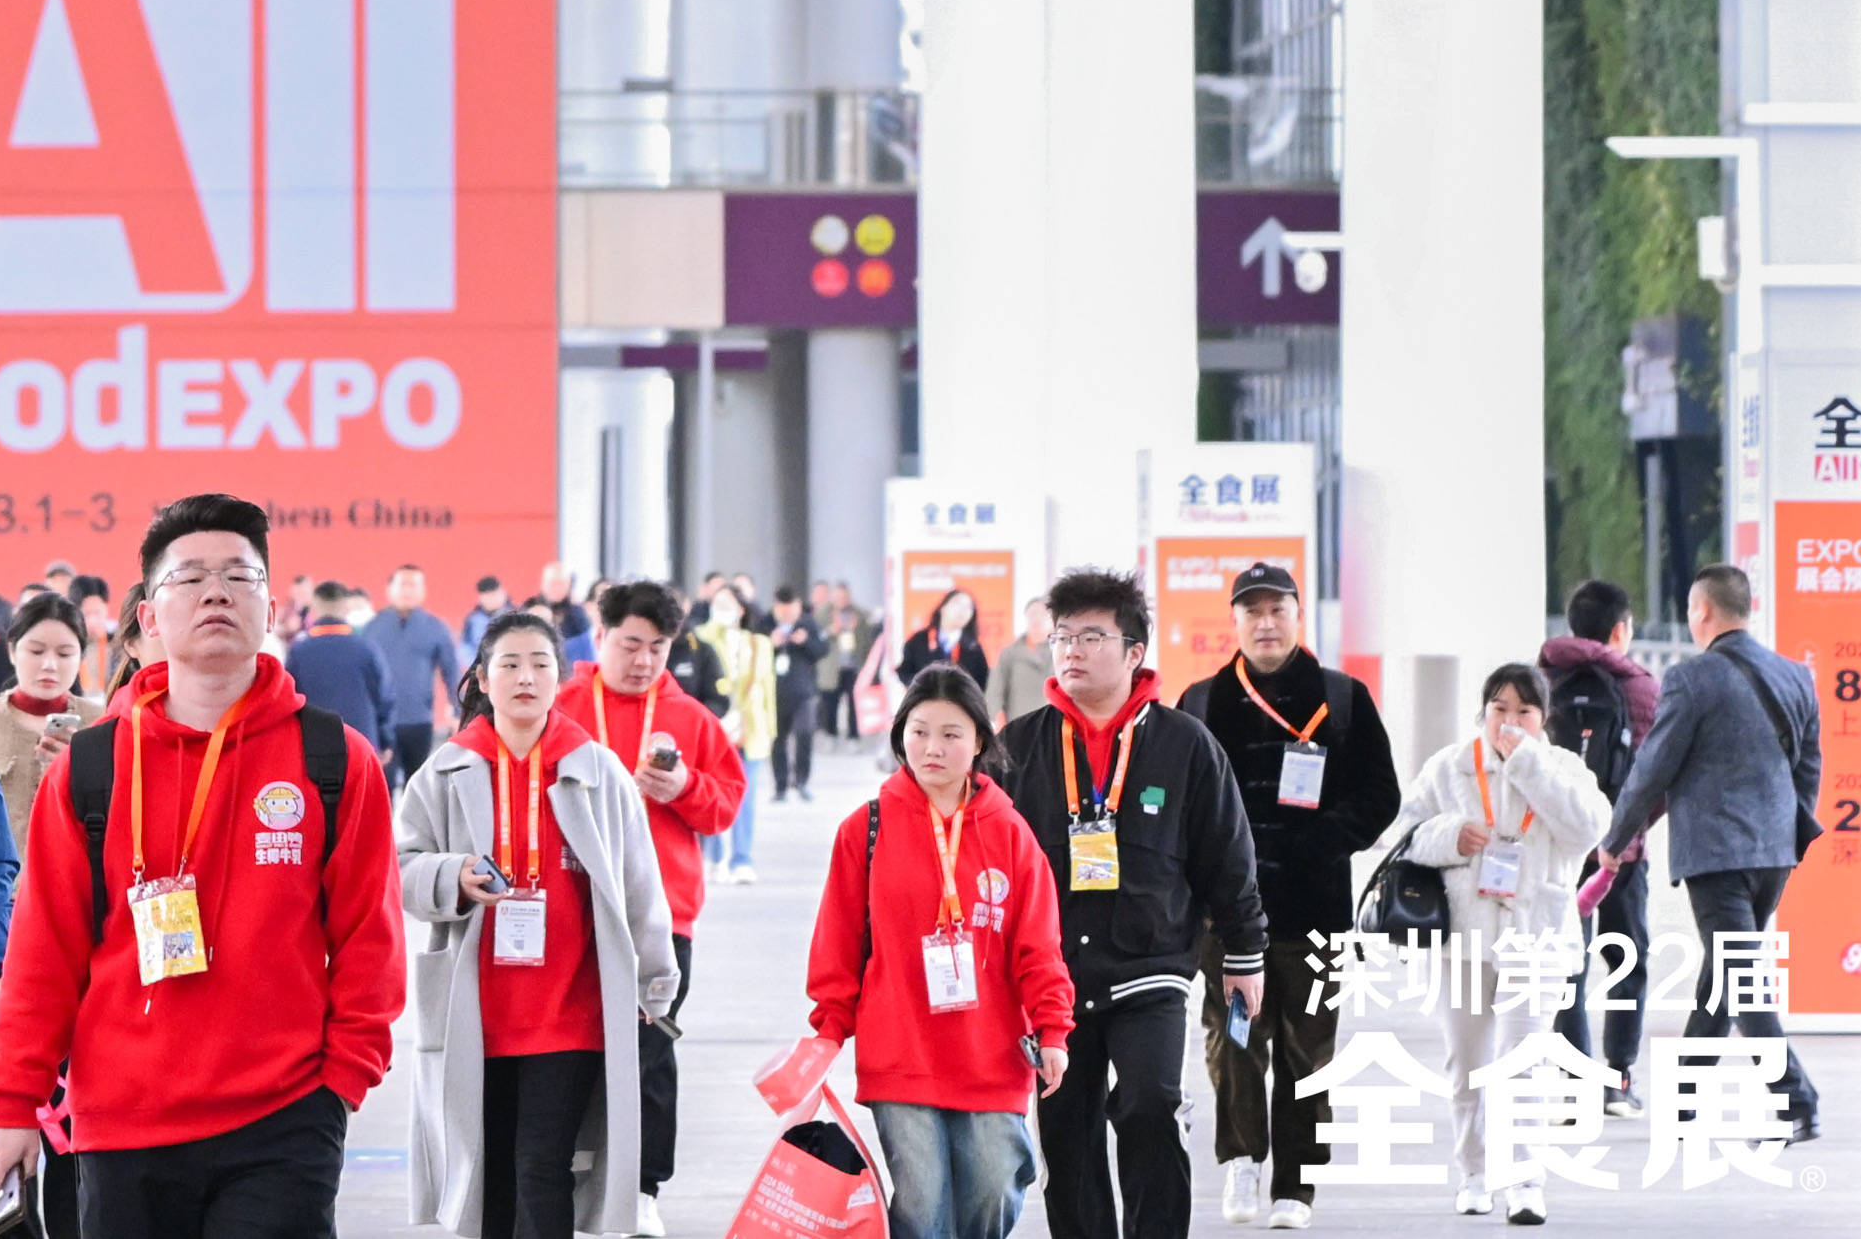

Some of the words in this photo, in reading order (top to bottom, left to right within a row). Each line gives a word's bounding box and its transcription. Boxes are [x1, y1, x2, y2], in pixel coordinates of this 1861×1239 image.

[1813, 397, 1861, 449] 全
[1178, 473, 1281, 505] 全食展
[348, 499, 453, 529] China
